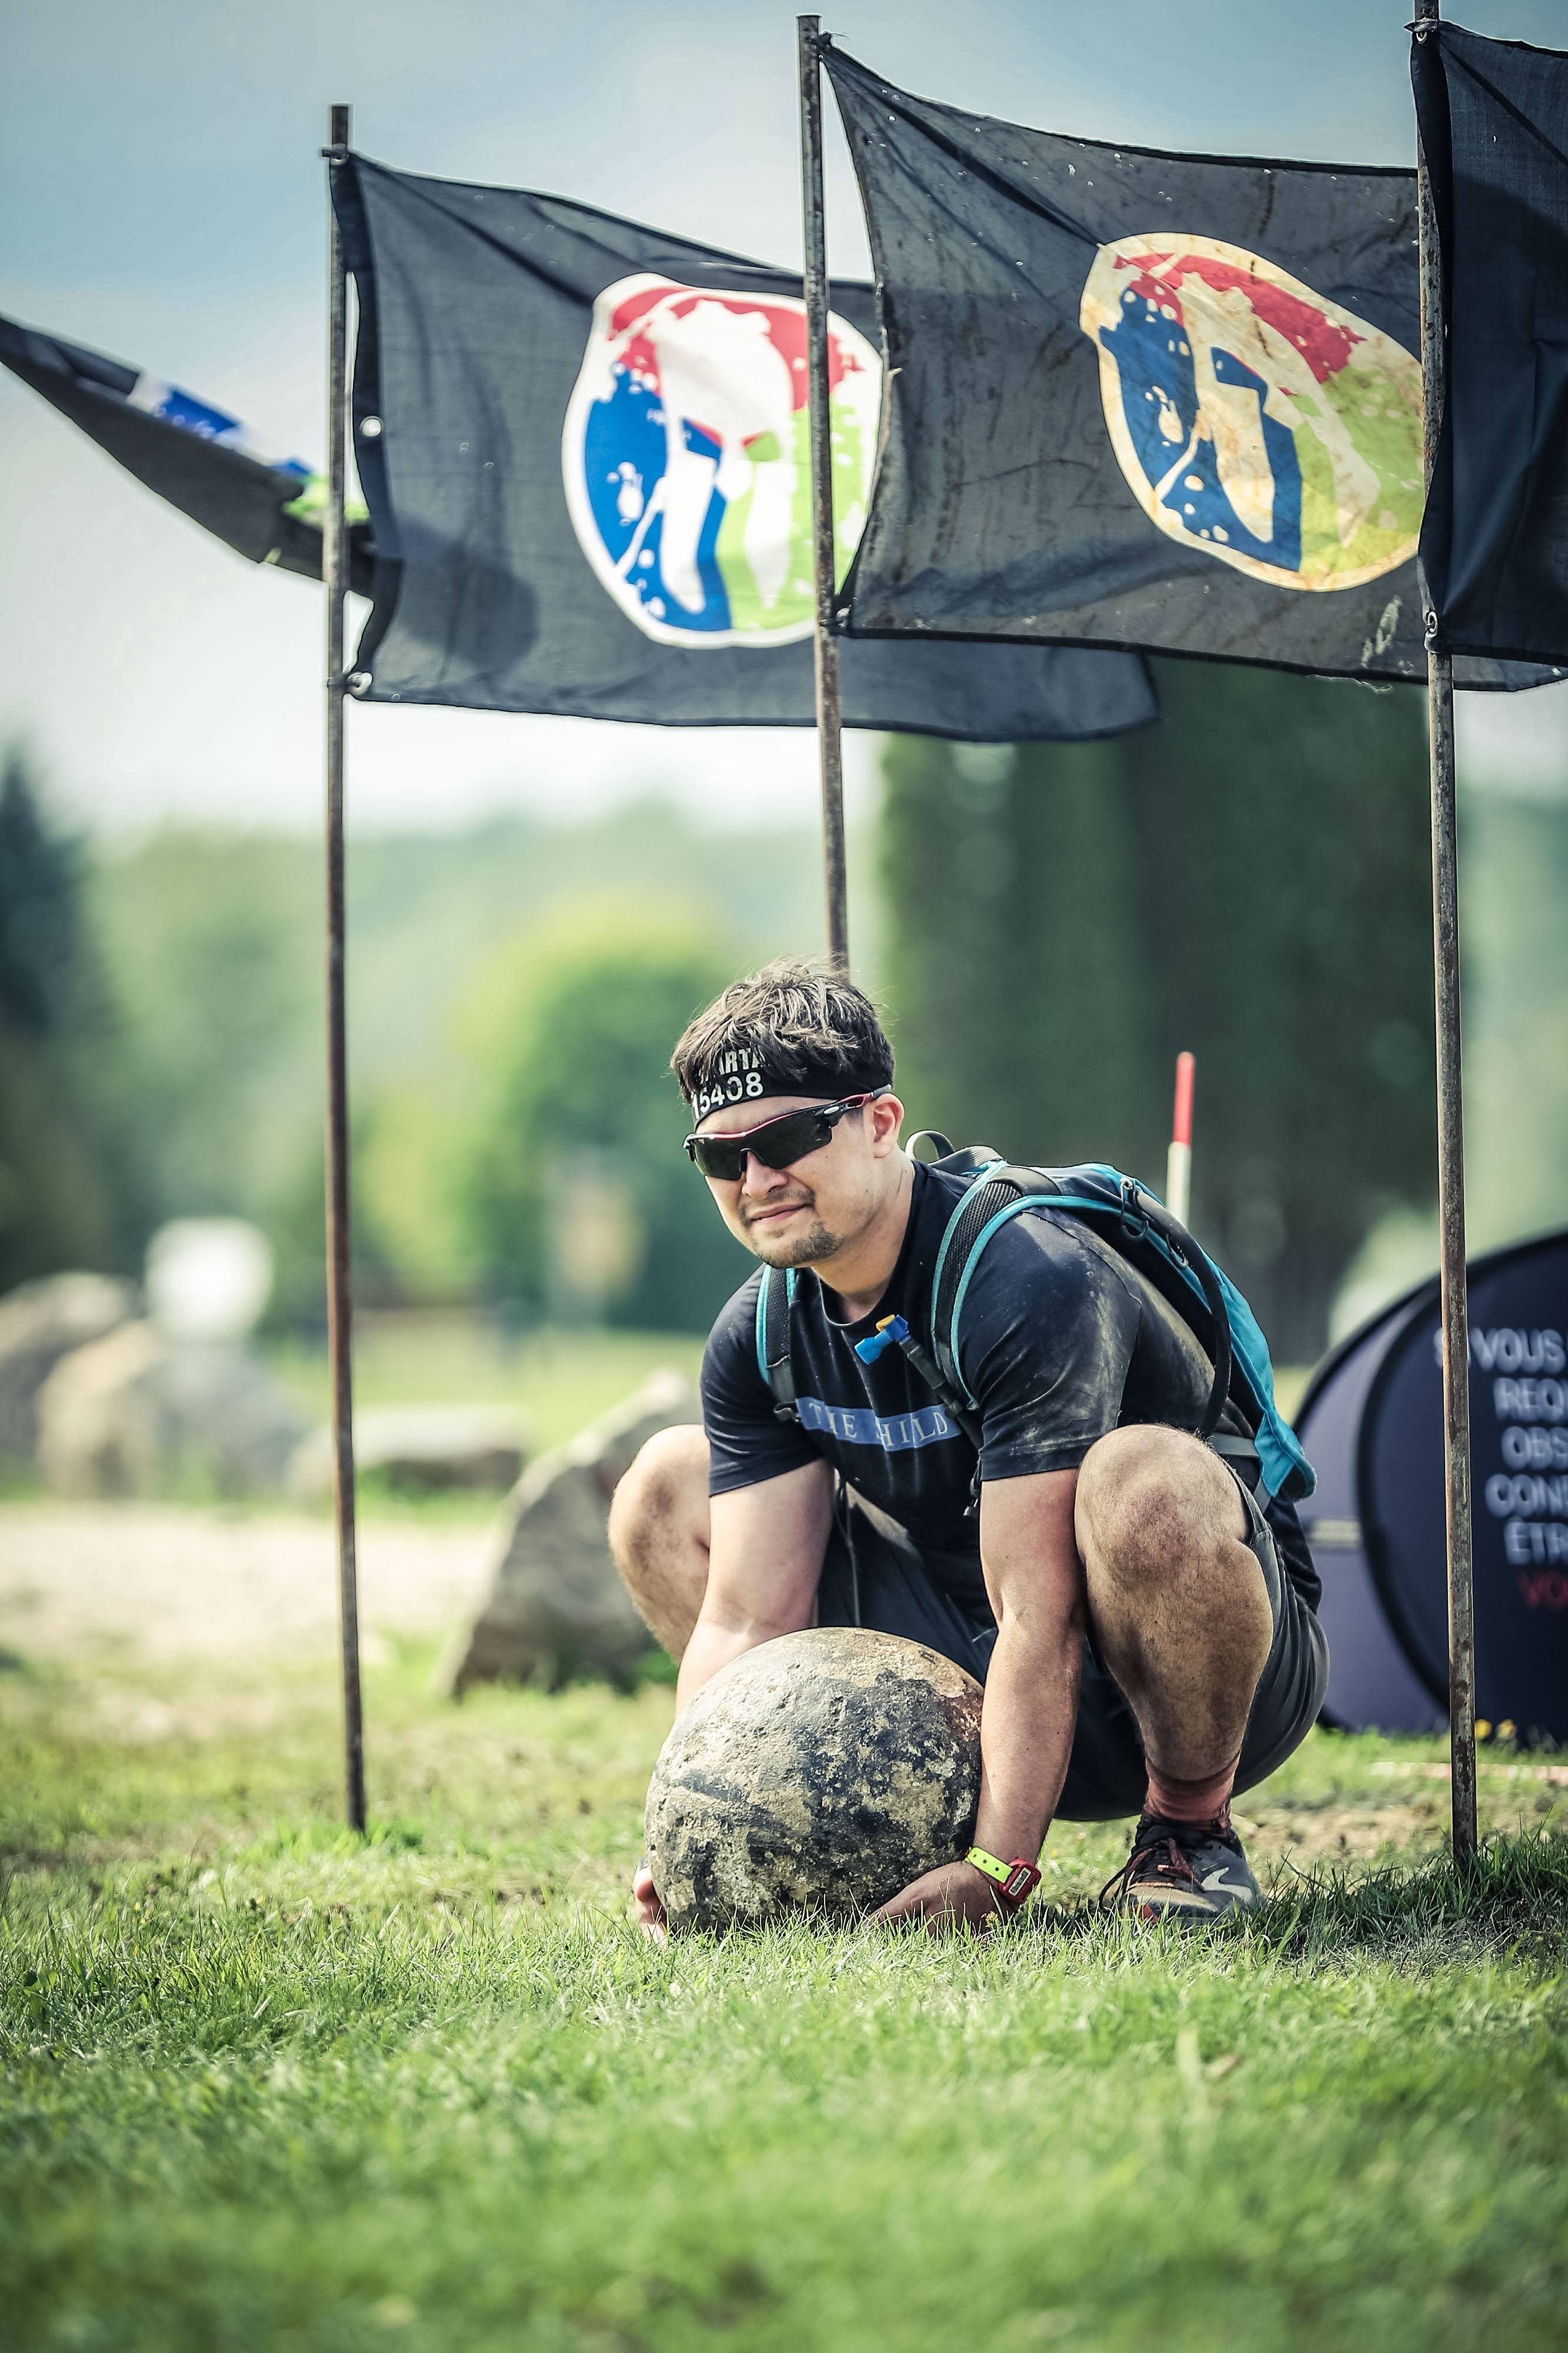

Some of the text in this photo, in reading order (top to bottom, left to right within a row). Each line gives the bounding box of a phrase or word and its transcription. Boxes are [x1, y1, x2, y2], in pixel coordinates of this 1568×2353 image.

[1470, 1327, 1566, 1374] VOUS
[1493, 1377, 1568, 1422] REQ
[1484, 1473, 1568, 1518] CON
